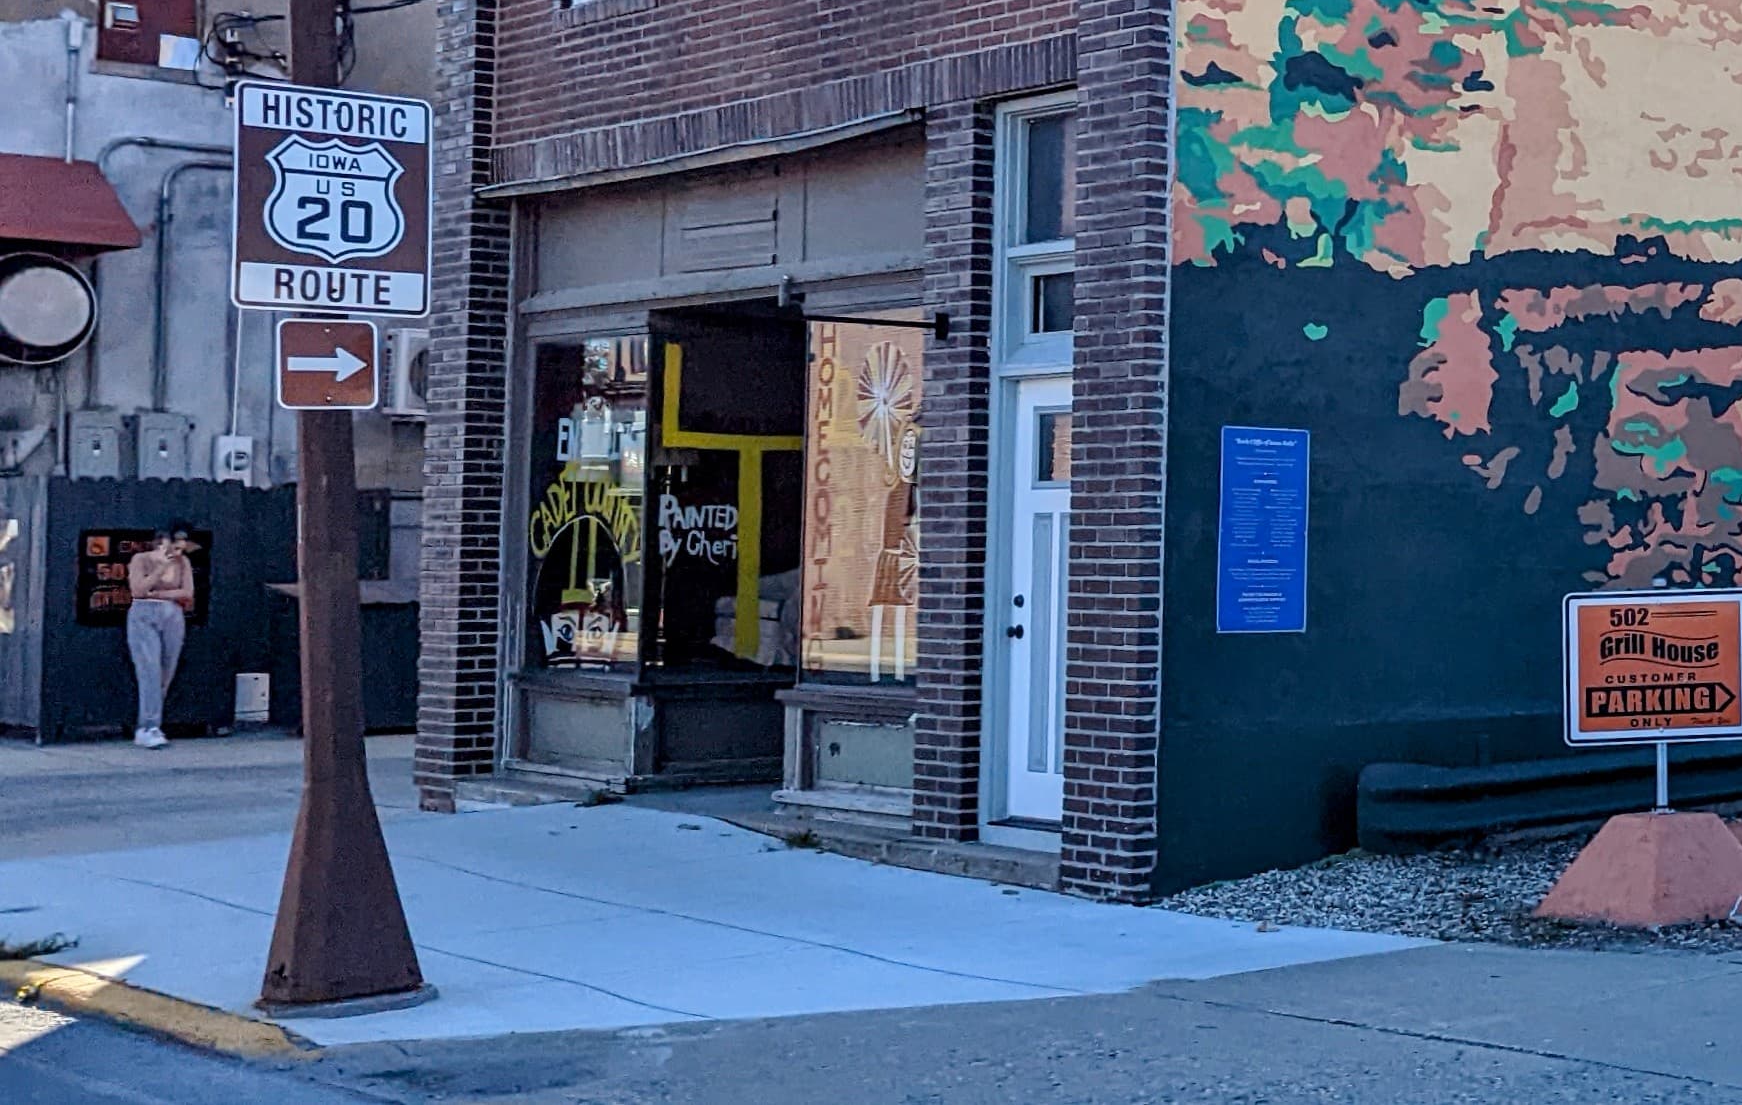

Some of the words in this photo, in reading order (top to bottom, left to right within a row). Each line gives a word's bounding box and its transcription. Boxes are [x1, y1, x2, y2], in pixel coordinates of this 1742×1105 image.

[261, 92, 408, 139] HISTORIC
[308, 153, 362, 173] IOWA
[316, 180, 356, 197] US
[296, 196, 374, 244] 20
[274, 268, 392, 306] ROUTE
[658, 494, 739, 531] PAINTED
[1609, 608, 1649, 627] 502
[1600, 633, 1645, 660] Grill
[1652, 637, 1719, 663] House
[1605, 672, 1696, 684] CUSTOMER
[1591, 685, 1711, 714] PARKING
[1630, 717, 1673, 727] ONLY
